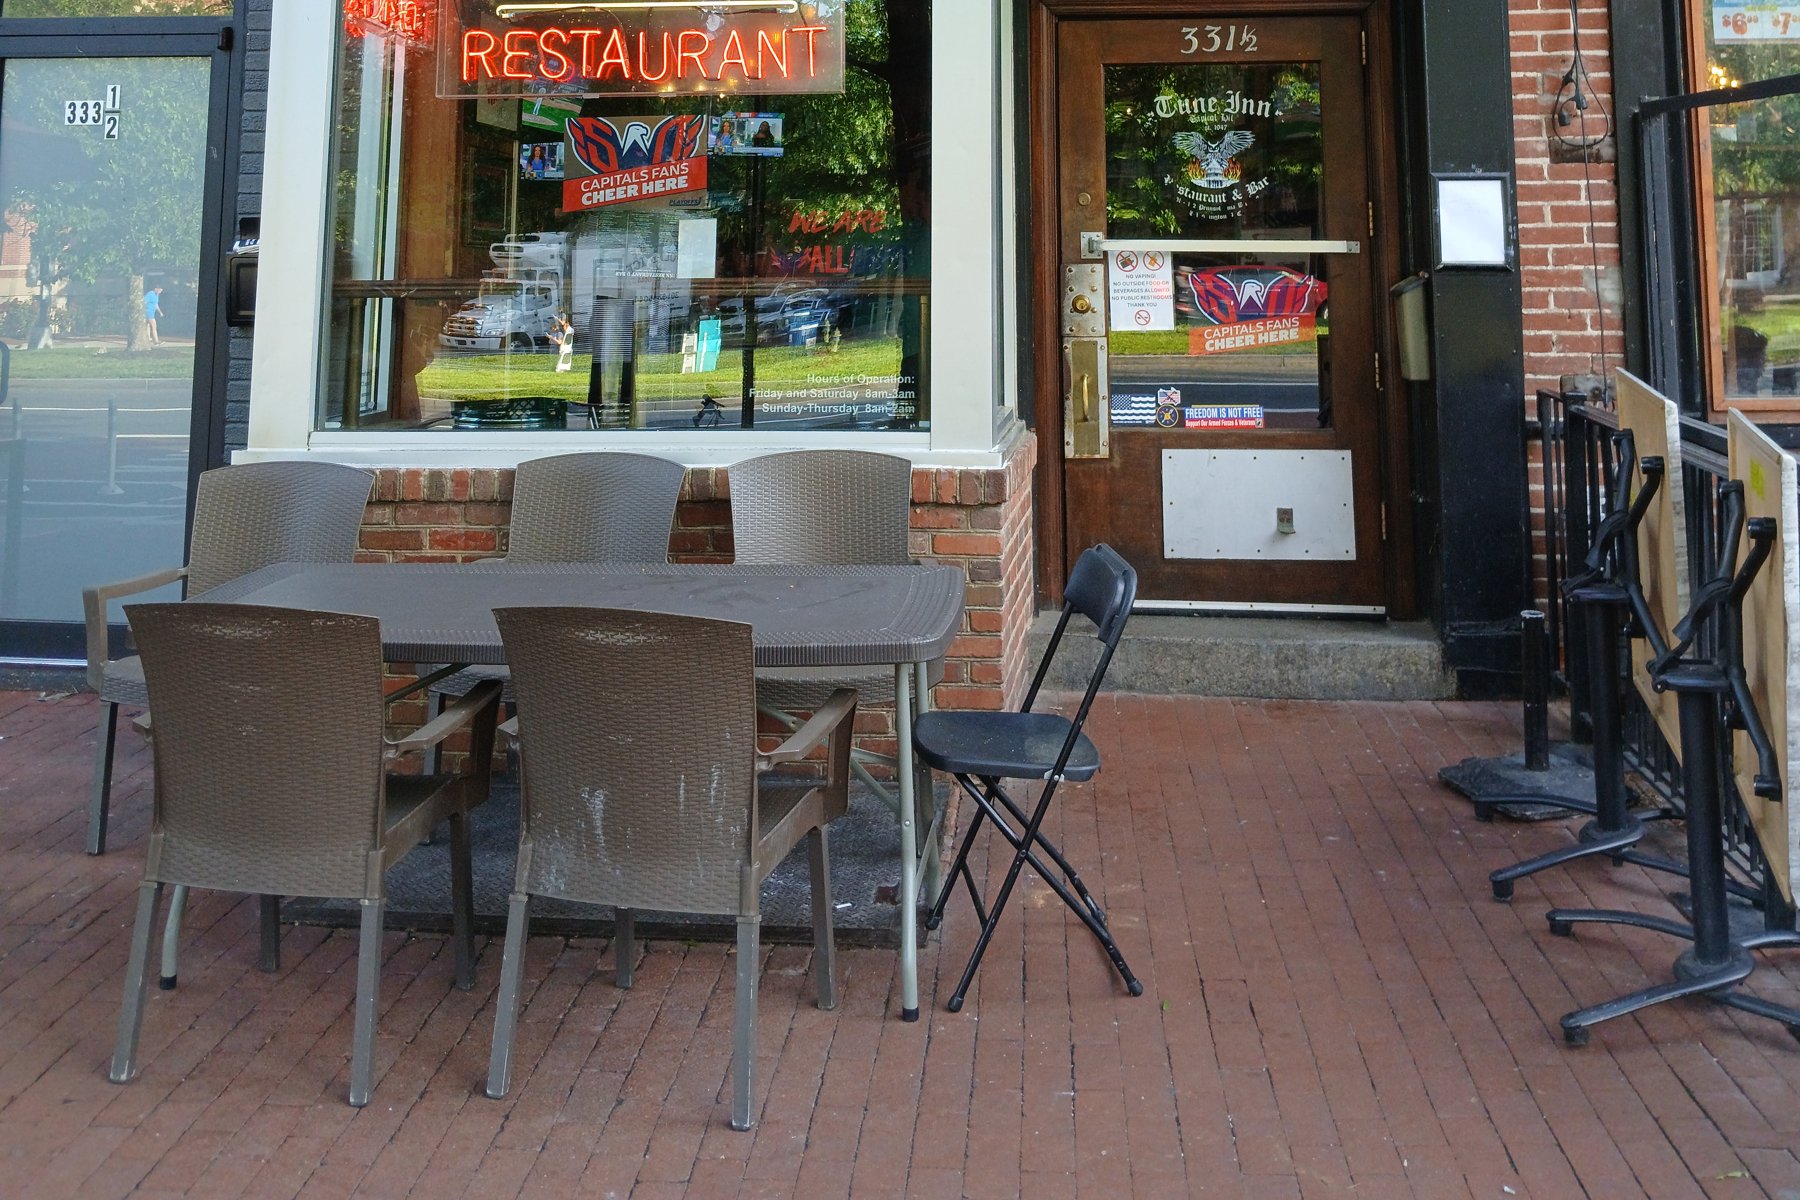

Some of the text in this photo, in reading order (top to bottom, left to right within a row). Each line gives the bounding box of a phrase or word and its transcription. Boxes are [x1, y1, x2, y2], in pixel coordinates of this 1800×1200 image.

[463, 26, 827, 81] RESTAURANT
[67, 102, 101, 124] 333
[1154, 90, 1271, 118] Tune Inn
[580, 169, 649, 192] CAPITALS
[651, 162, 689, 180] FANS
[1231, 188, 1243, 201] &
[1245, 176, 1269, 197] Bar
[581, 175, 689, 206] CHEER HERE
[788, 209, 888, 234] WE ARE
[809, 245, 849, 273] ALL
[1204, 317, 1299, 339] CAPITALS FANS
[1205, 328, 1299, 351] CHEER HERE
[807, 374, 915, 385] Hours of Operation:
[749, 389, 915, 400] Friday and Saturday 8am-3am
[762, 403, 859, 415] Sunday-Thursday
[1186, 407, 1263, 418] FREEDOM IS NOT FREE!
